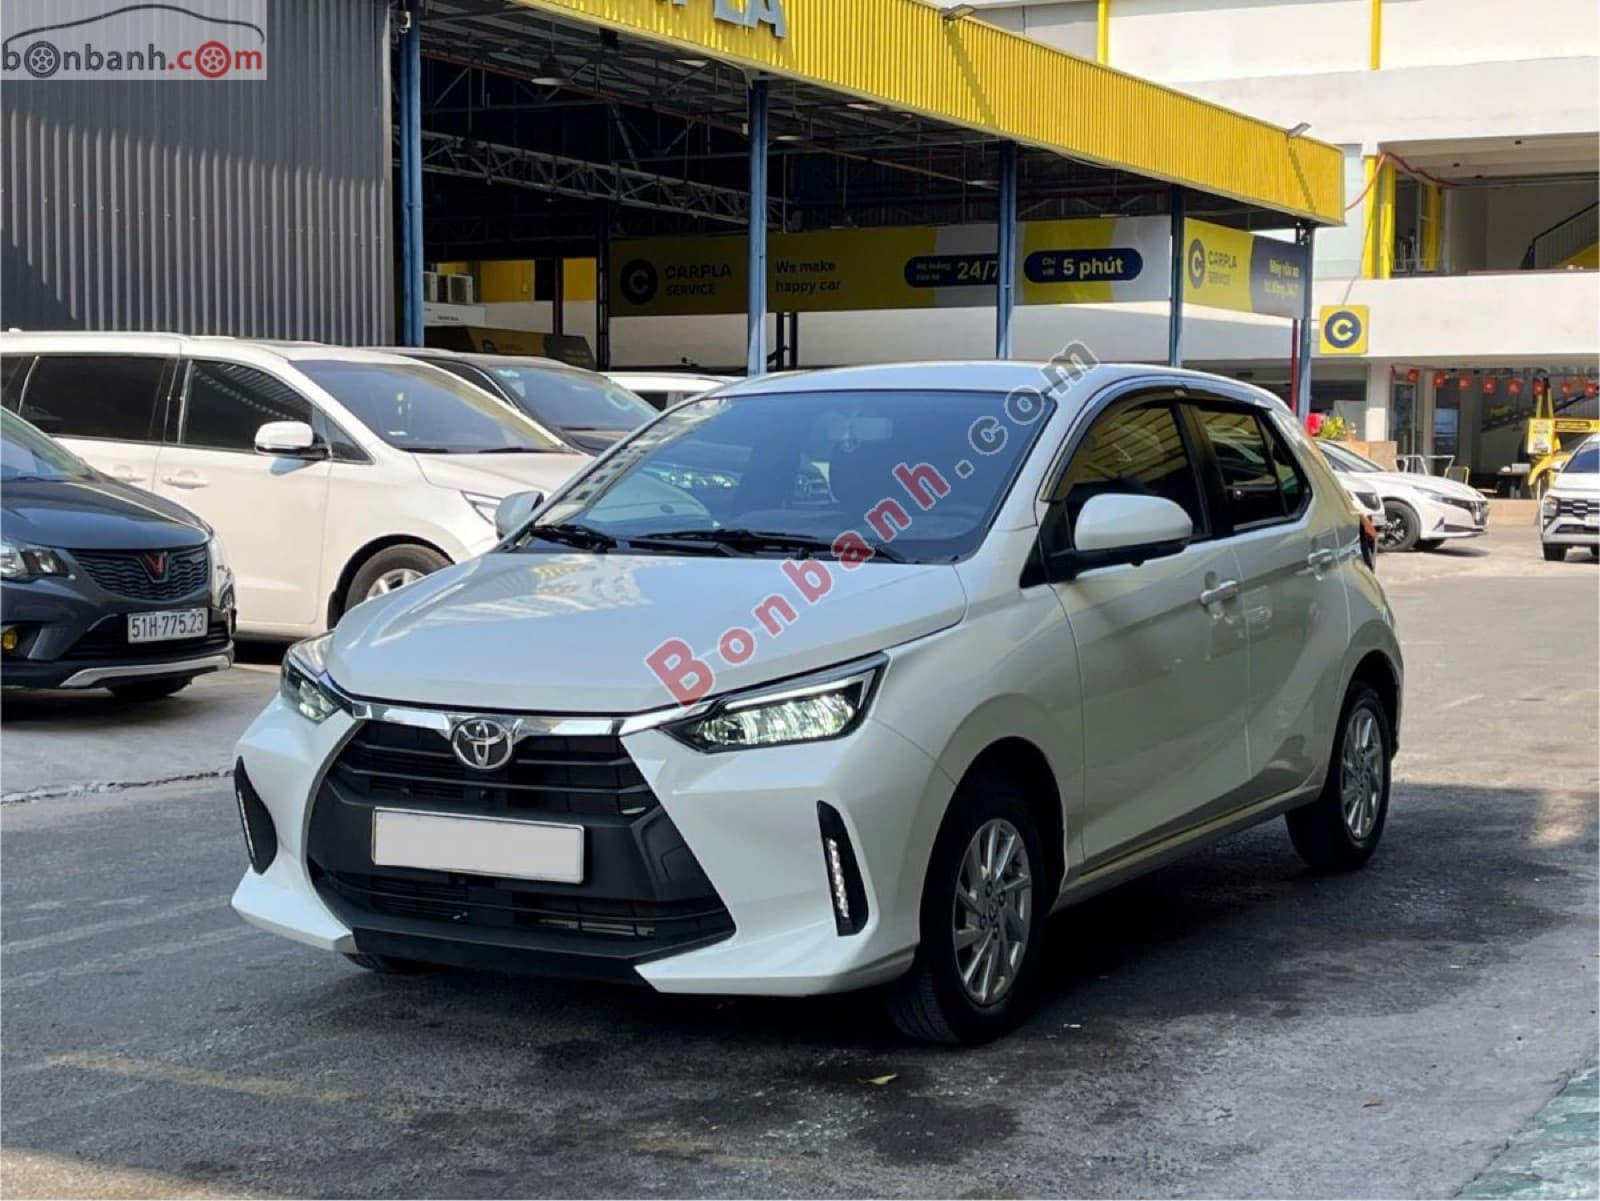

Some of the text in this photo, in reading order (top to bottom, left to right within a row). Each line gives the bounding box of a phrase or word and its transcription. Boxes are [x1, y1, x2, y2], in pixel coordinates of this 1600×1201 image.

[664, 263, 732, 280] CARPLA
[776, 258, 836, 273] We make
[1062, 258, 1075, 275] 5
[1079, 256, 1124, 280] phút
[665, 282, 715, 297] SERVICE
[776, 280, 841, 295] happy car
